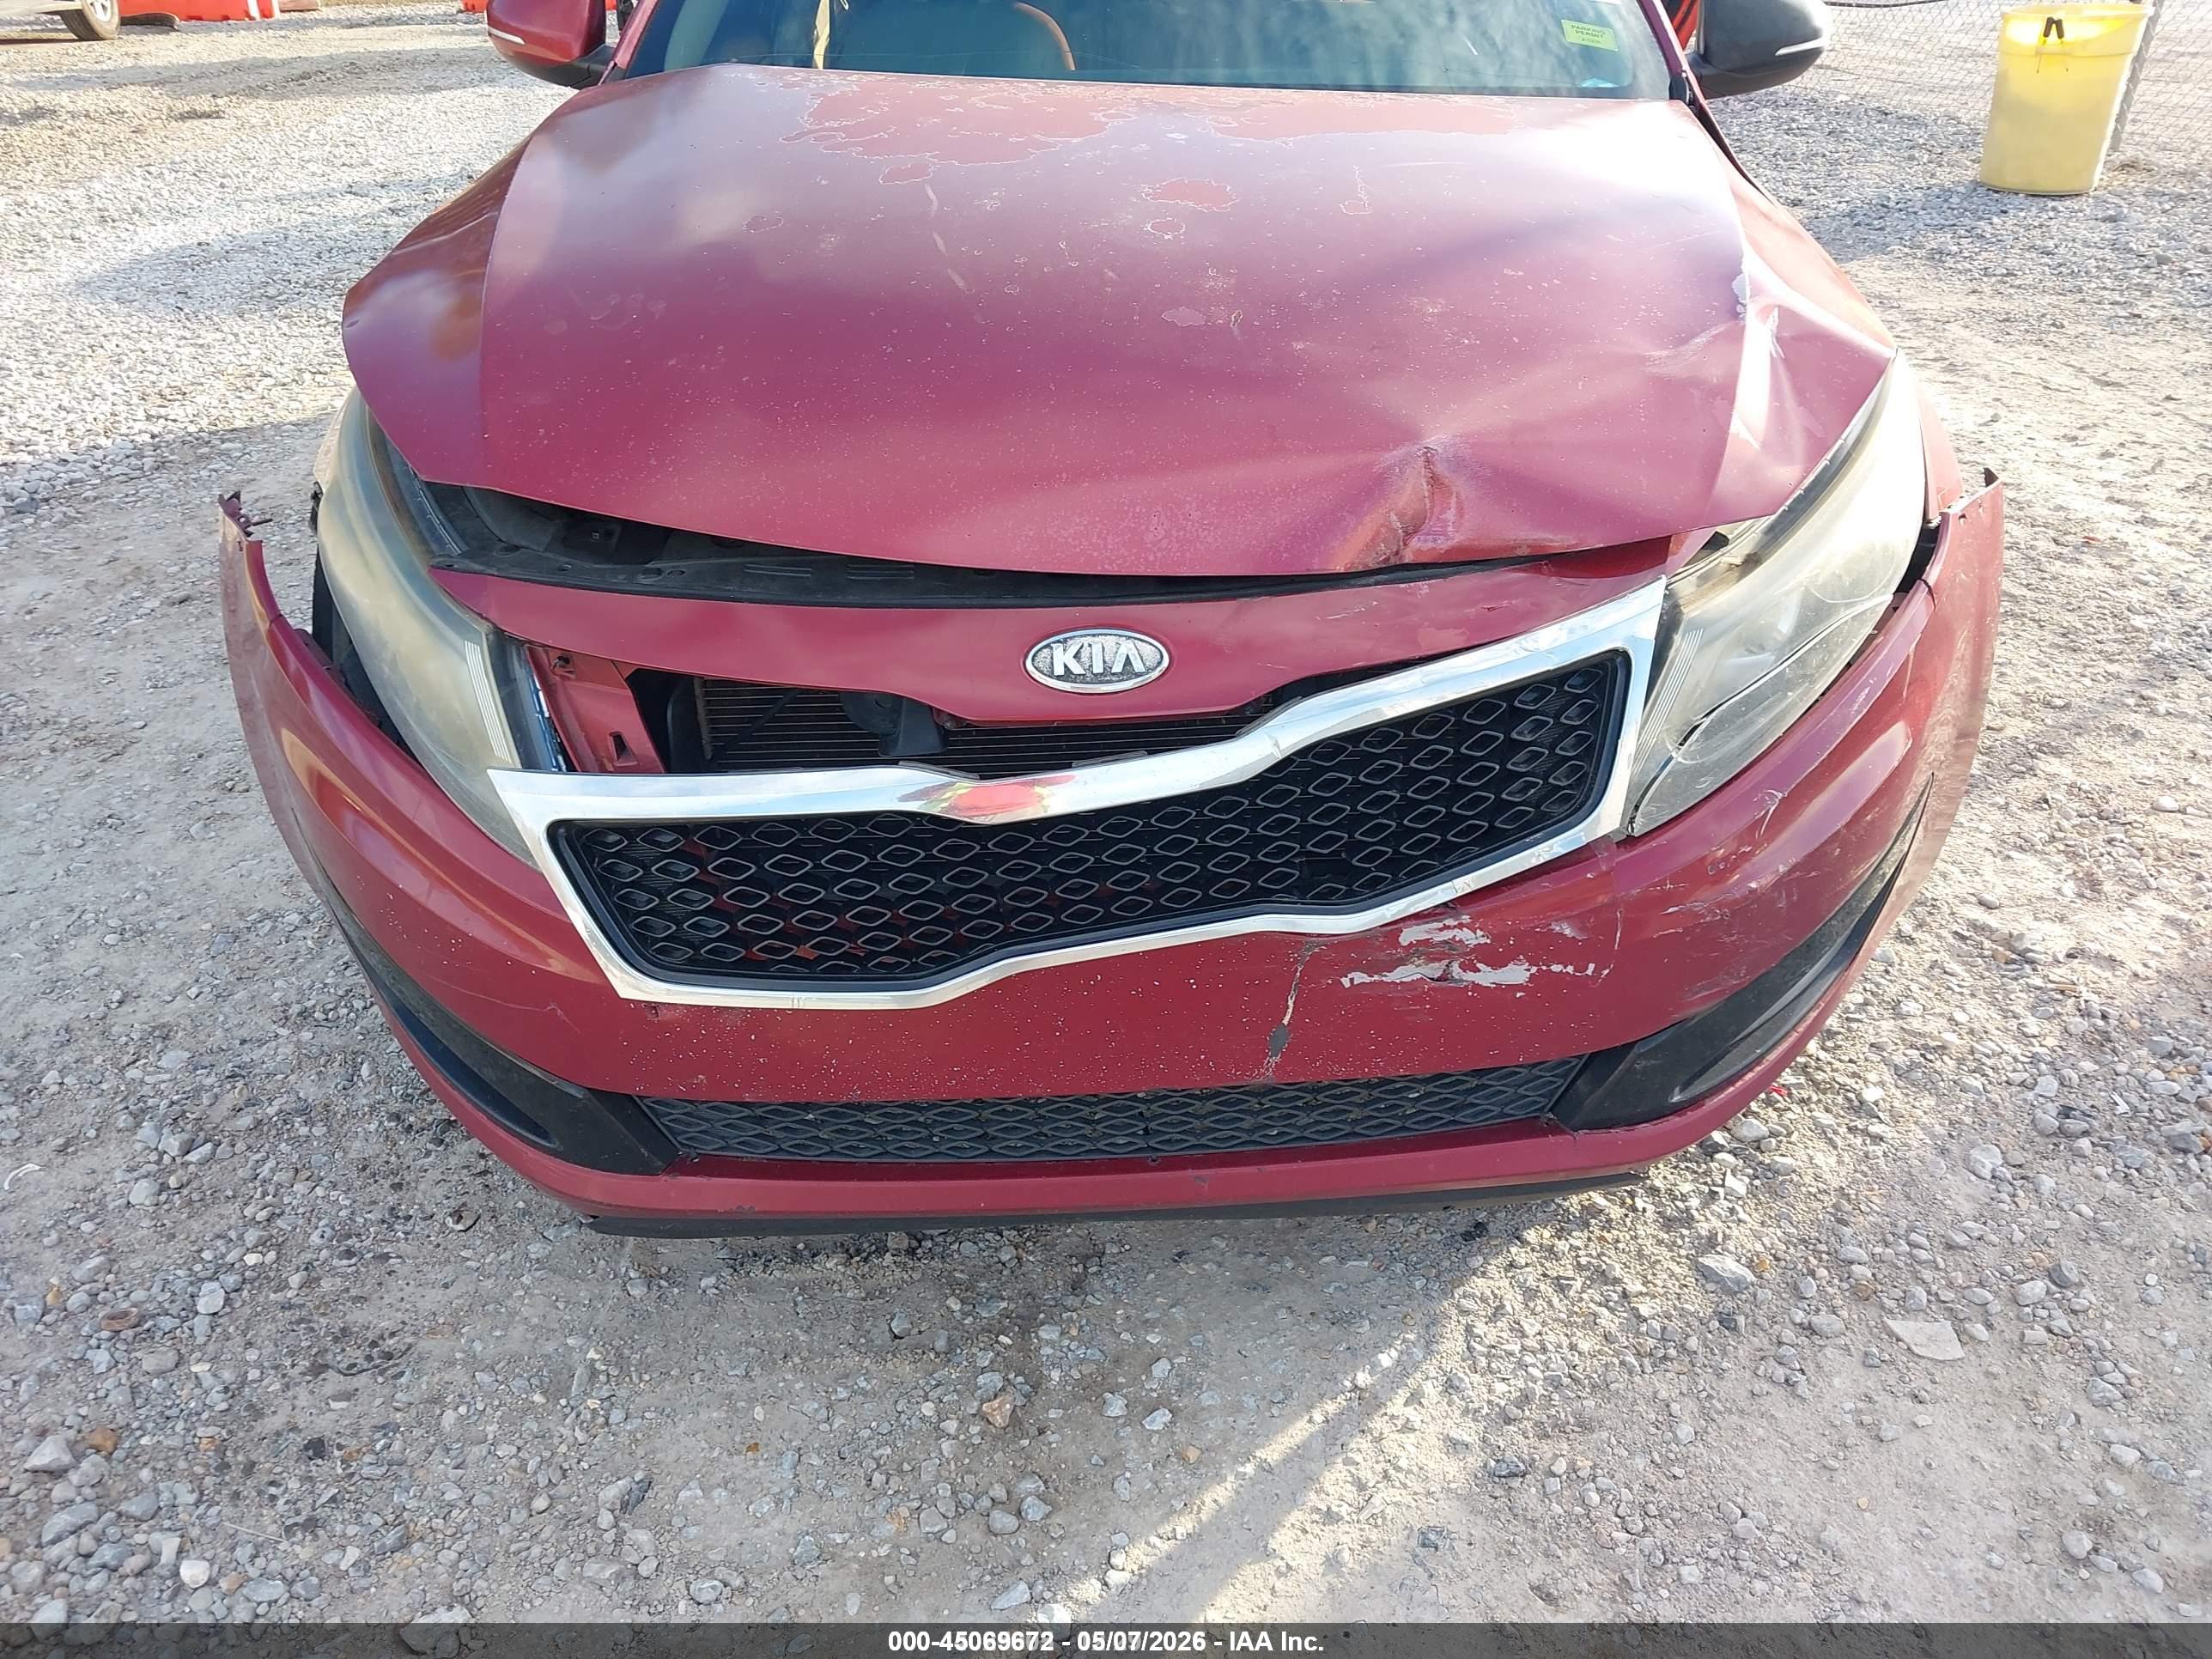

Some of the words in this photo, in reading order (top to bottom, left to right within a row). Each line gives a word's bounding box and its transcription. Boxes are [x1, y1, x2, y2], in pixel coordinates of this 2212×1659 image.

[1571, 24, 1606, 34] PARKING
[1575, 29, 1604, 39] PERMIT
[1050, 641, 1147, 676] KIA
